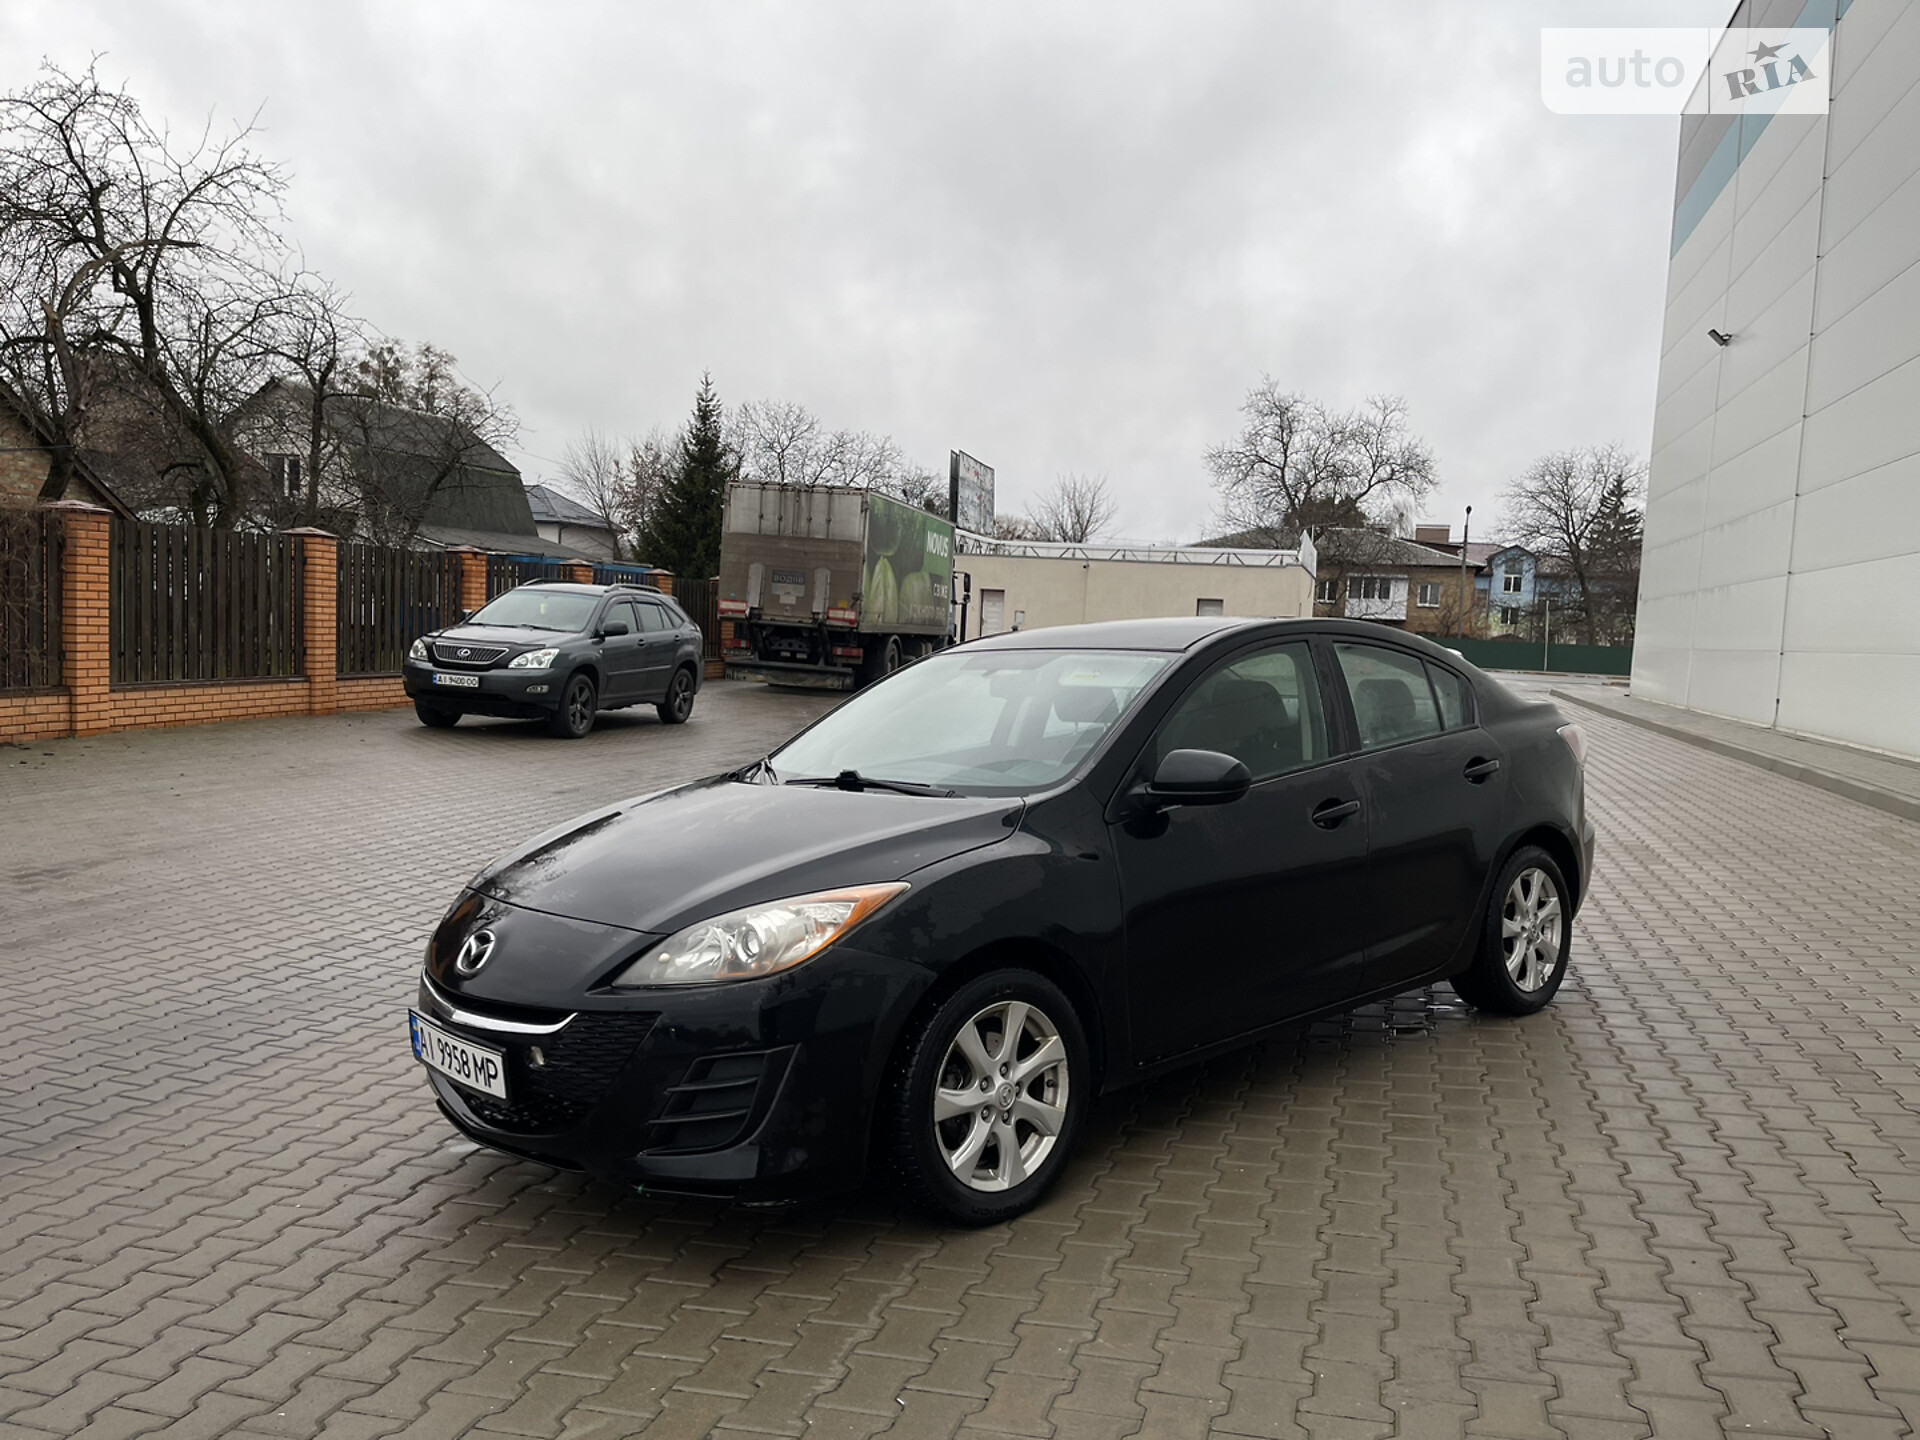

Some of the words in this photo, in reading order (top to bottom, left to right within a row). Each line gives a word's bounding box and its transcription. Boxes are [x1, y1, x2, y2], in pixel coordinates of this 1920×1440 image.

[926, 530, 949, 558] NOVUS
[420, 1026, 434, 1060] AI
[437, 1037, 471, 1079] 9958
[472, 1052, 498, 1088] MP
